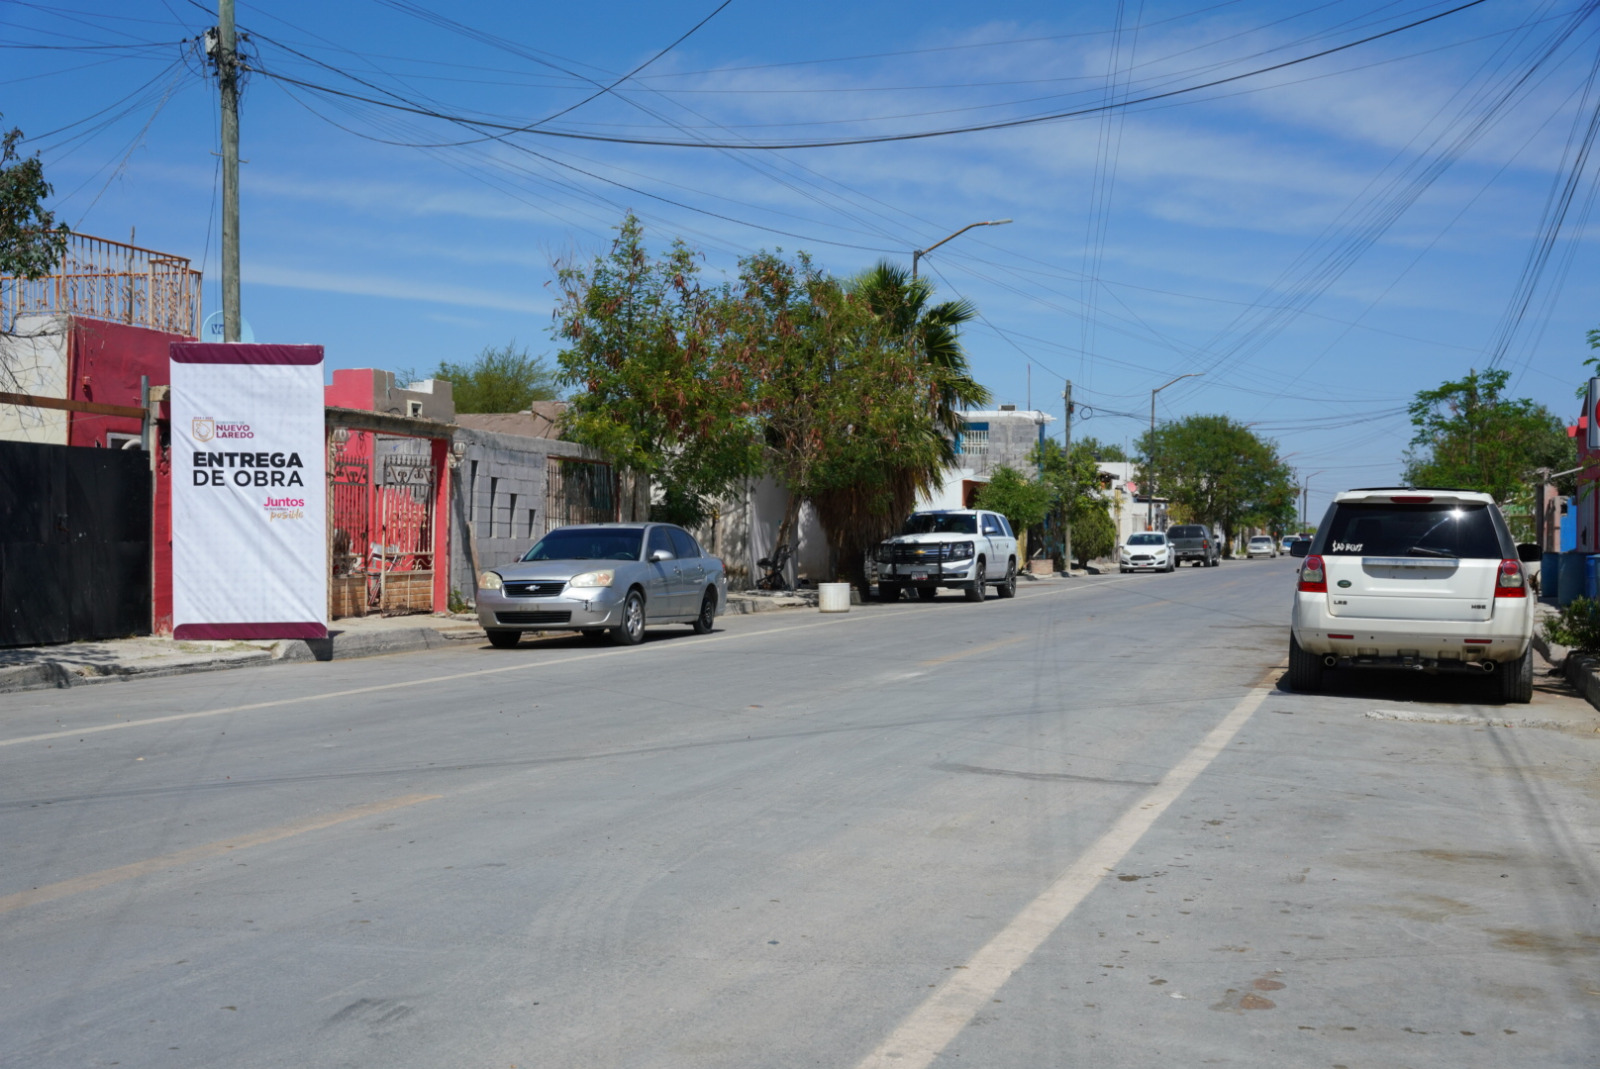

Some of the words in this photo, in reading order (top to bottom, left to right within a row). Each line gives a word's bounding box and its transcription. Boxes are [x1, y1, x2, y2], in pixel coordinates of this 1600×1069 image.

[193, 452, 304, 468] ENTREGA
[193, 470, 225, 486] DE
[233, 470, 304, 487] OBRA
[263, 496, 305, 507] Juntos
